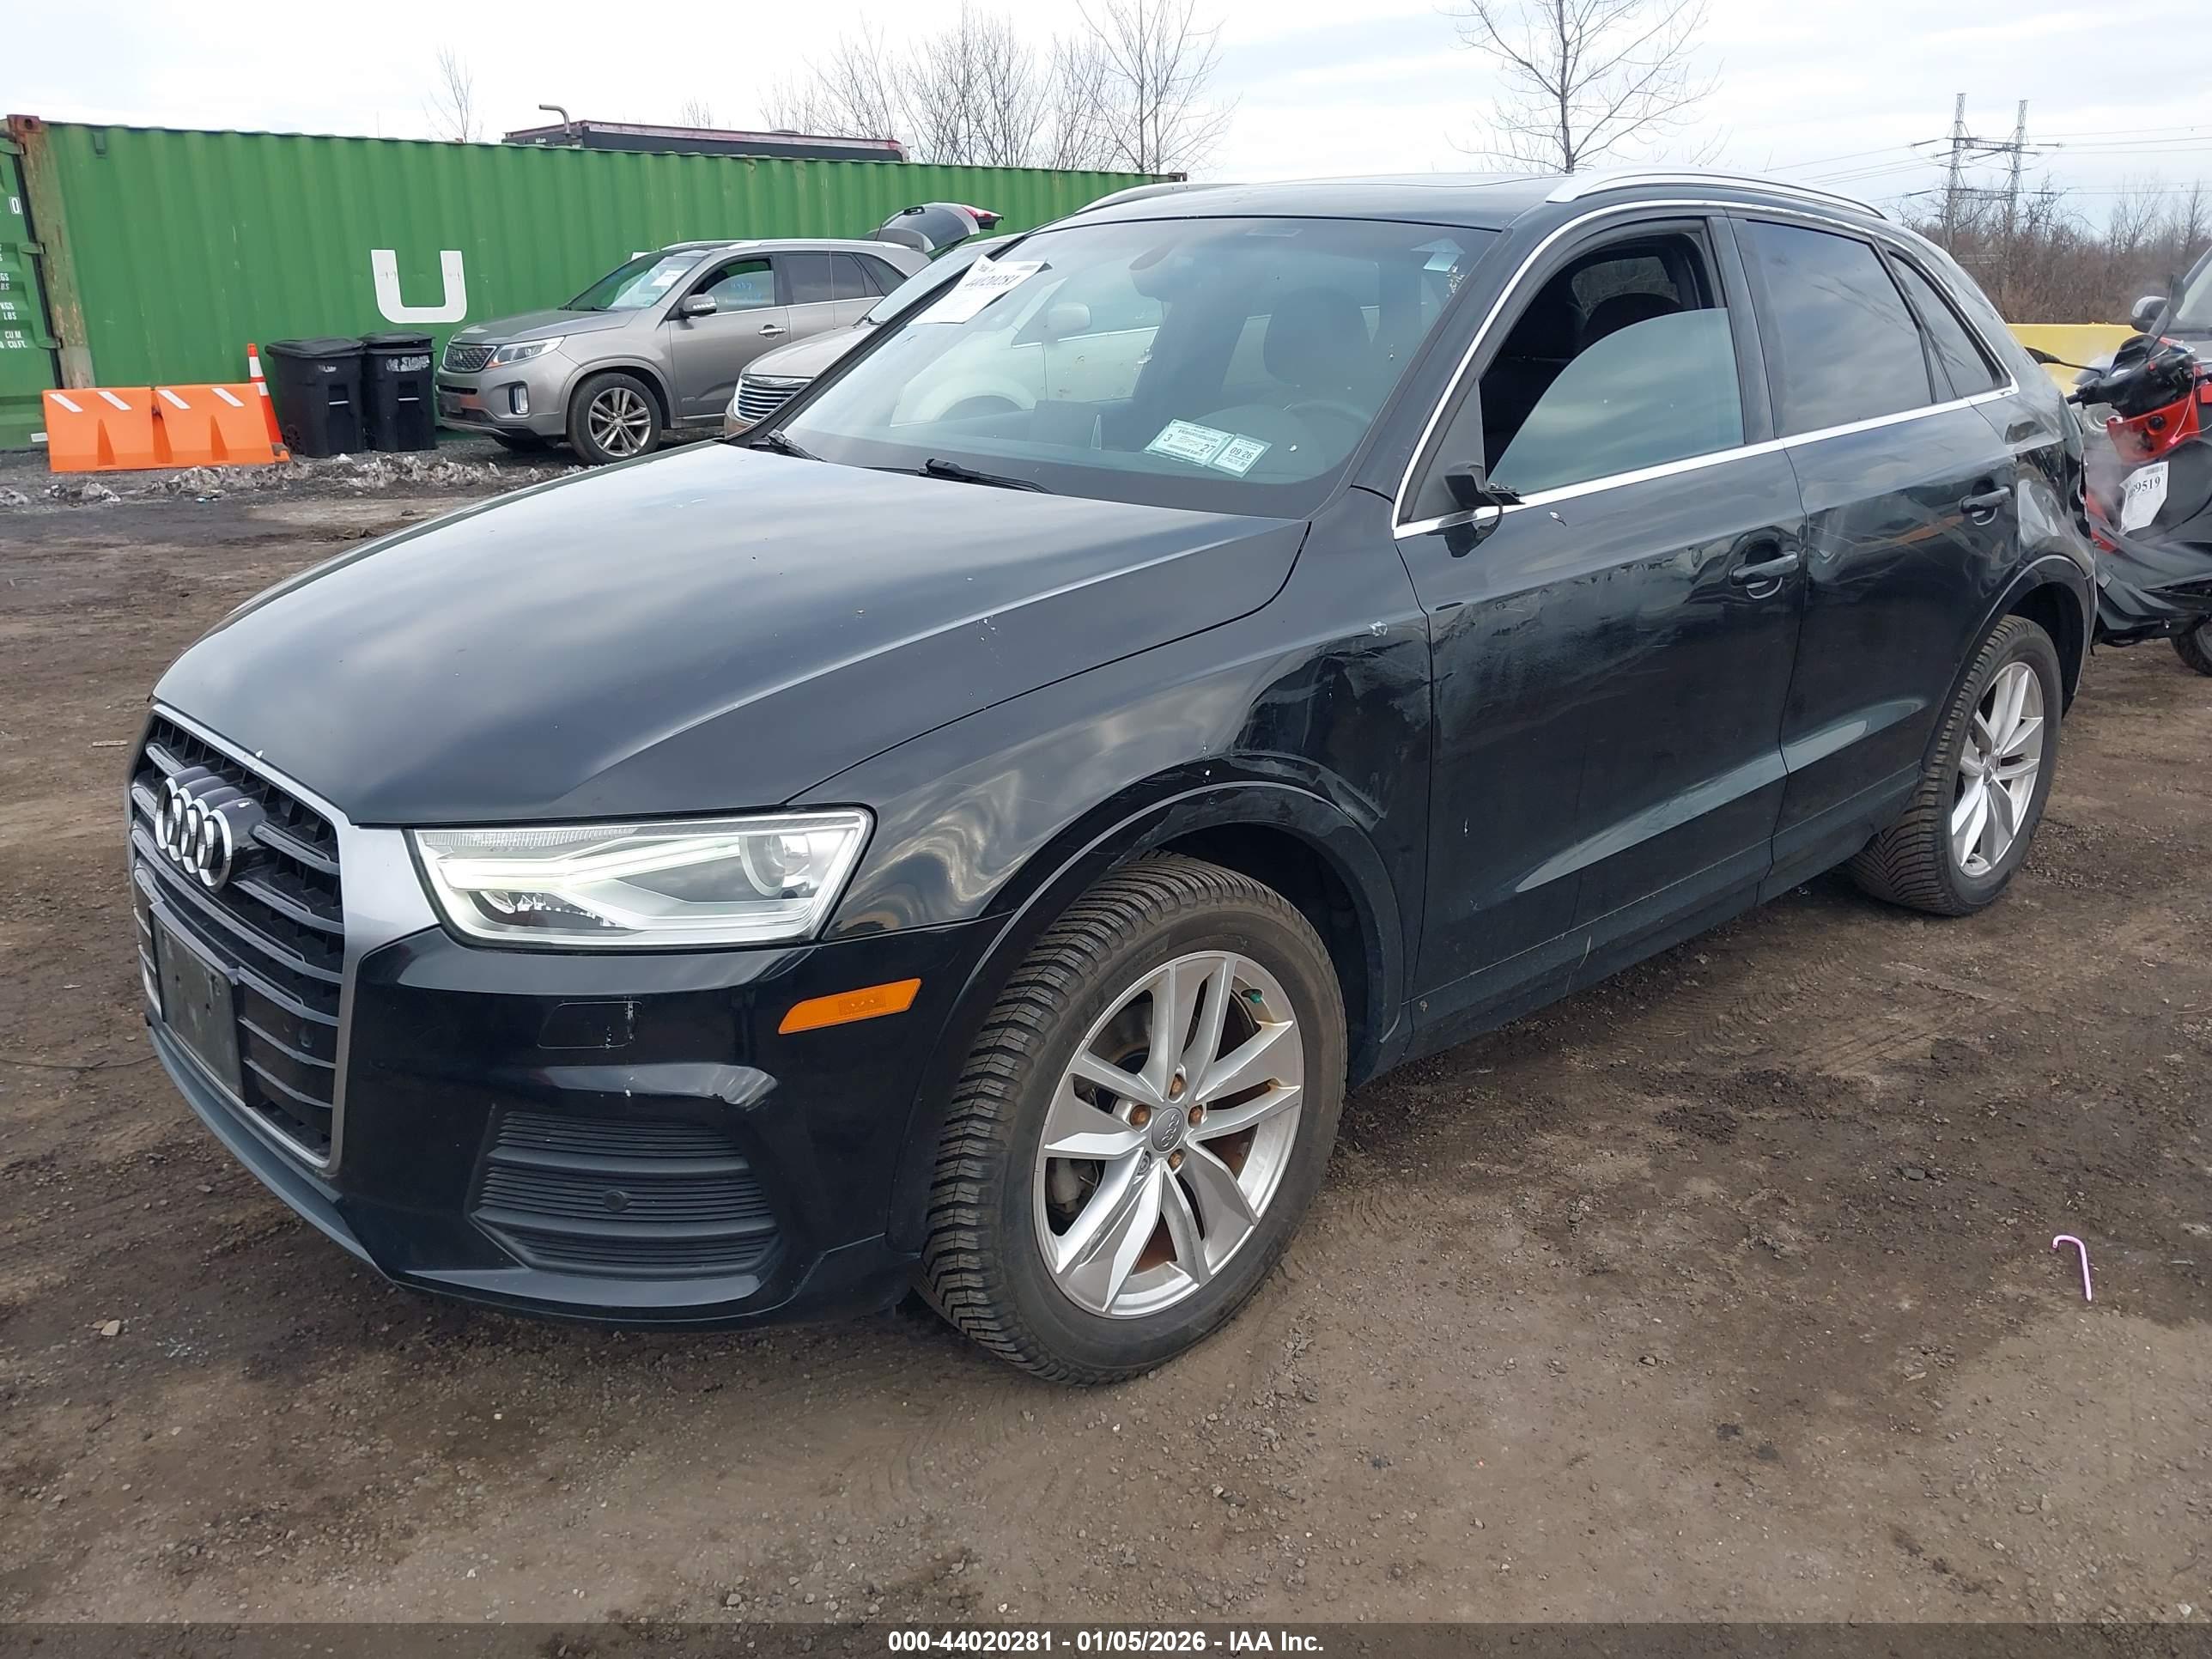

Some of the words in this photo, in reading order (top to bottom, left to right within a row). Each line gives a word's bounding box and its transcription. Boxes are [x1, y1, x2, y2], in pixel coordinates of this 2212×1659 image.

[370, 248, 469, 324] U
[3, 312, 17, 320] LBS
[1164, 434, 1173, 442] 3
[1202, 444, 1216, 453] 27
[1230, 447, 1242, 455] 09
[1243, 451, 1254, 459] 26
